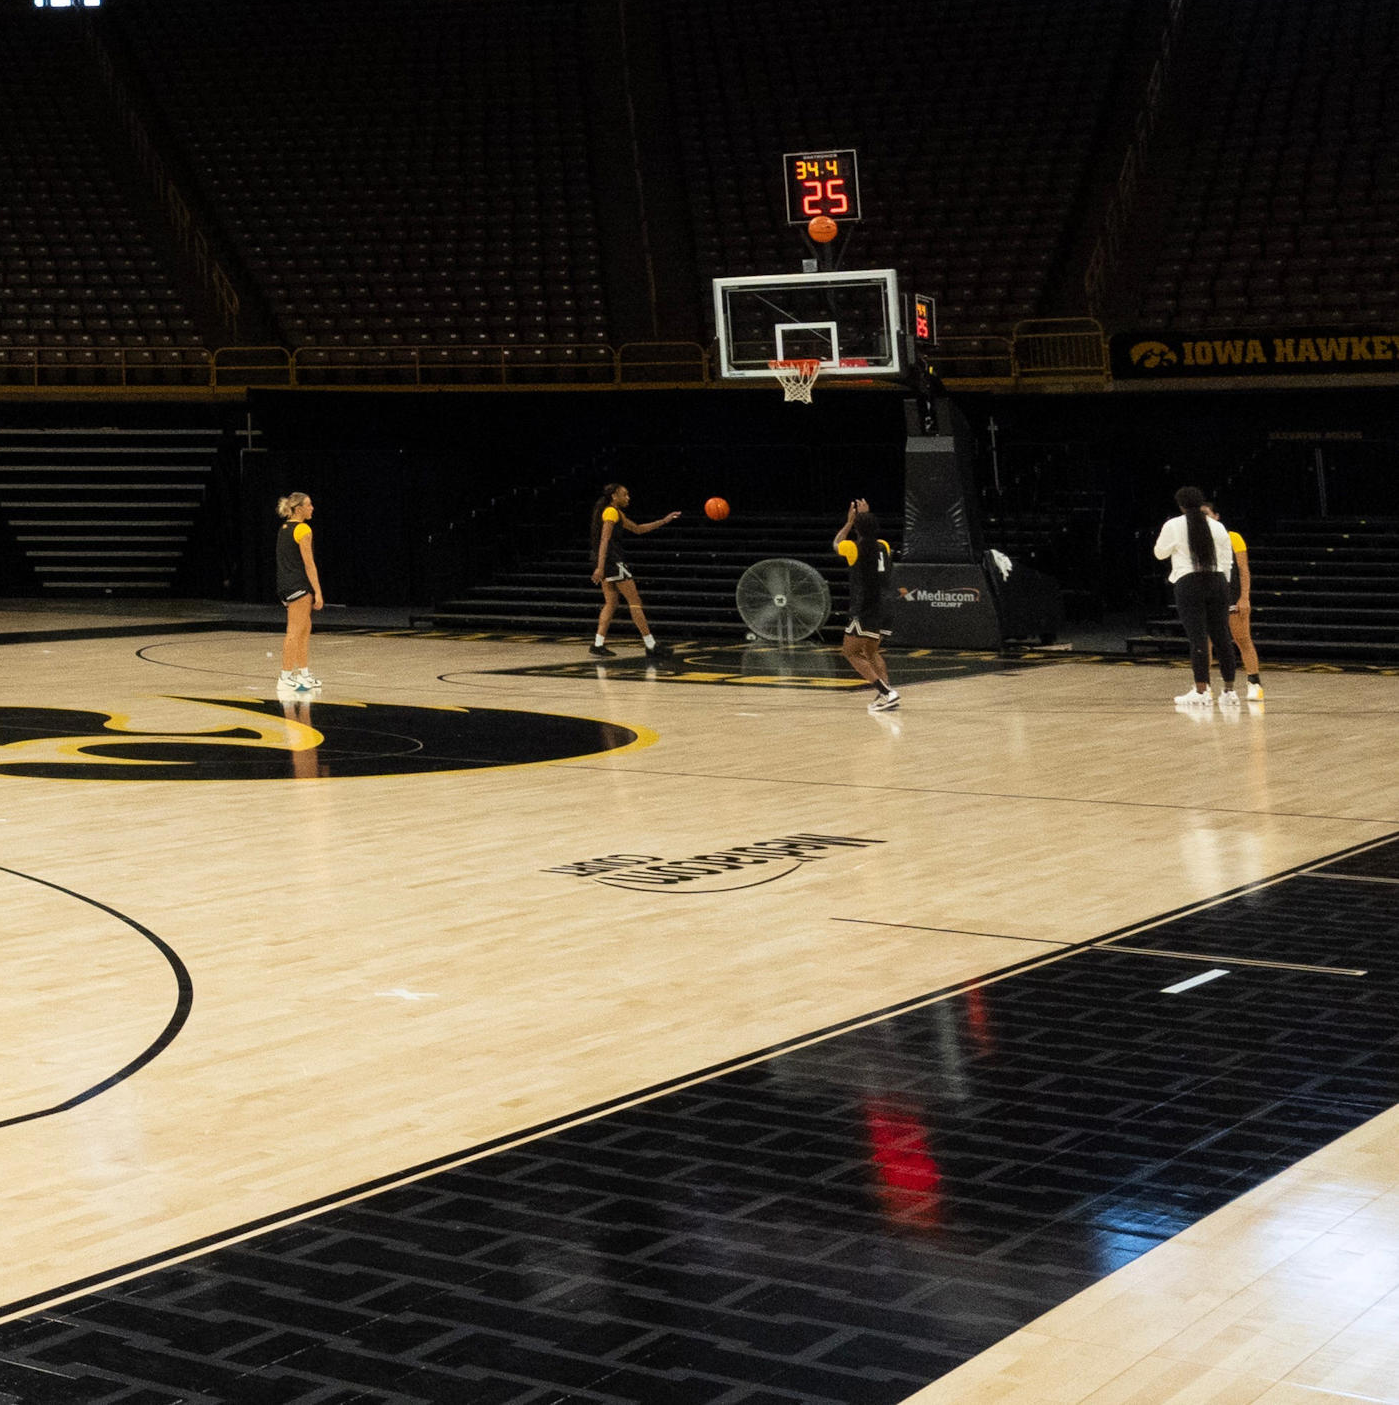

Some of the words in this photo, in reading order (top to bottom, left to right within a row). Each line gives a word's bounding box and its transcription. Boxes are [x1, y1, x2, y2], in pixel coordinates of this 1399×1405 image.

[796, 160, 838, 180] 34.4
[803, 179, 848, 215] 25
[1182, 340, 1267, 366] IOWA
[917, 590, 975, 602] Mediacom
